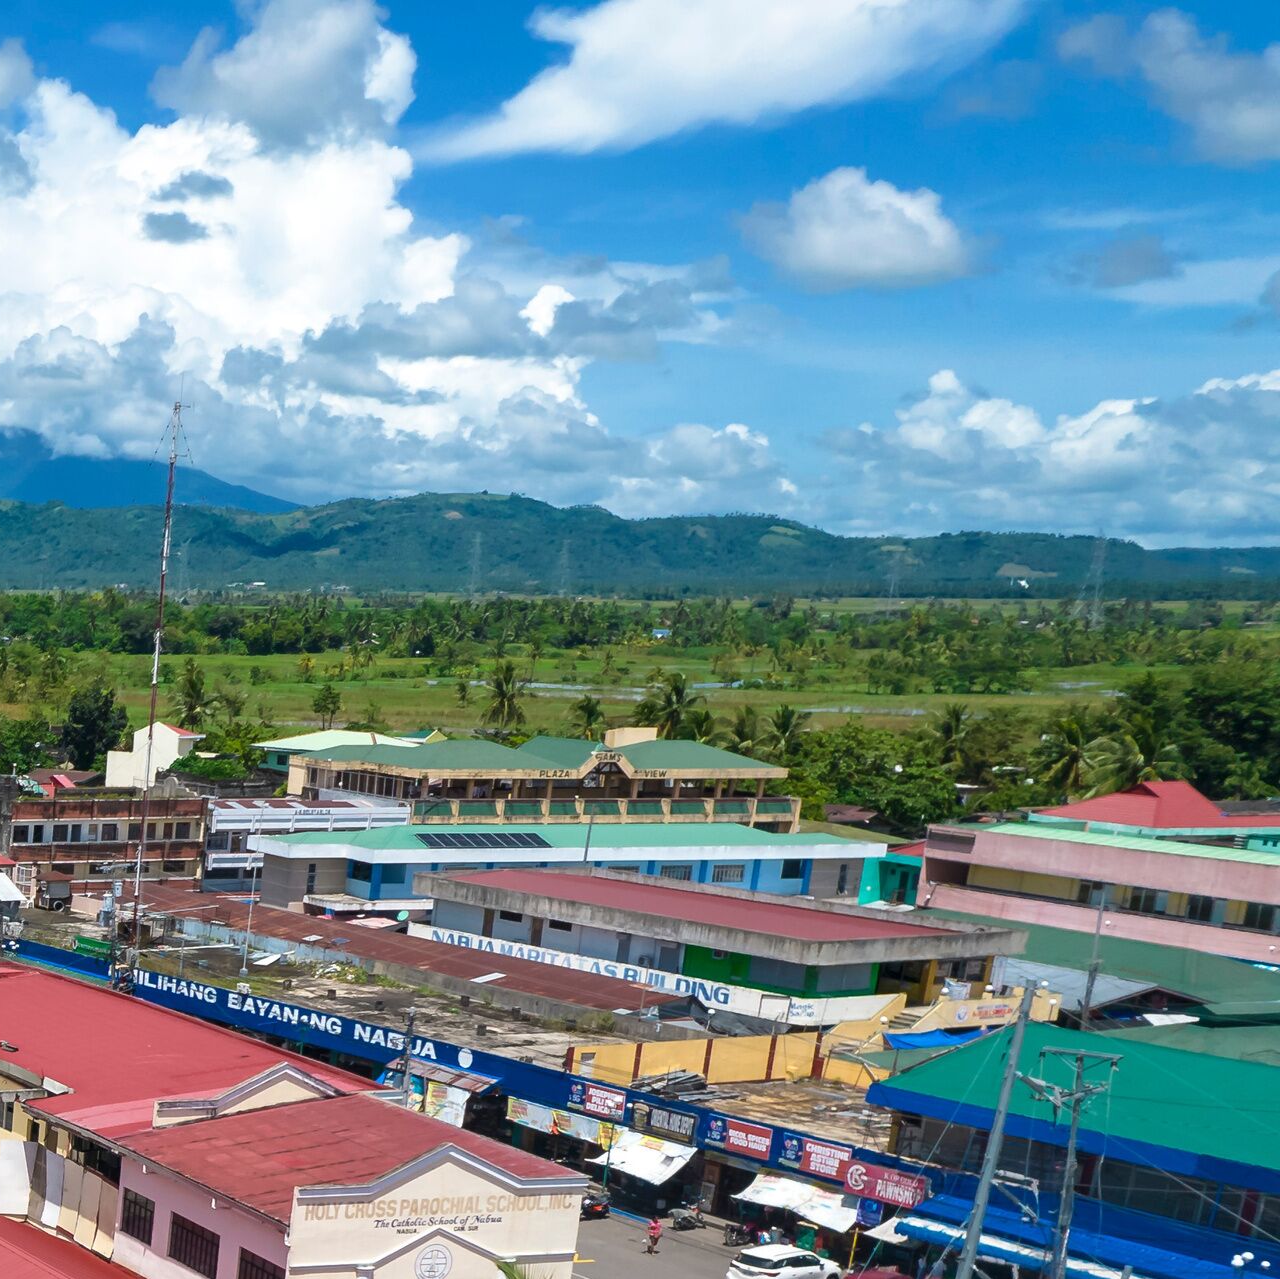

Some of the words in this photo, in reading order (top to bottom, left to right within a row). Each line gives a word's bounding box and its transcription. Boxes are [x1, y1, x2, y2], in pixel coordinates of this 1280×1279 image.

[539, 769, 570, 778] PLAZA
[644, 769, 668, 778] VIEW
[432, 929, 494, 952] NABUA
[227, 993, 299, 1025] BAYAN
[310, 1013, 342, 1035] NG
[353, 1023, 437, 1060] NABUA
[730, 1136, 748, 1147] FOOD
[810, 1161, 838, 1176] STORE
[304, 1203, 343, 1221] HOLY
[344, 1199, 397, 1219] CROSS
[399, 1194, 482, 1216] PAROCHIAL
[373, 1219, 390, 1229] The
[391, 1216, 427, 1228] Catholic
[427, 1216, 457, 1227] School
[457, 1215, 470, 1227] of
[471, 1215, 503, 1225] Nabua
